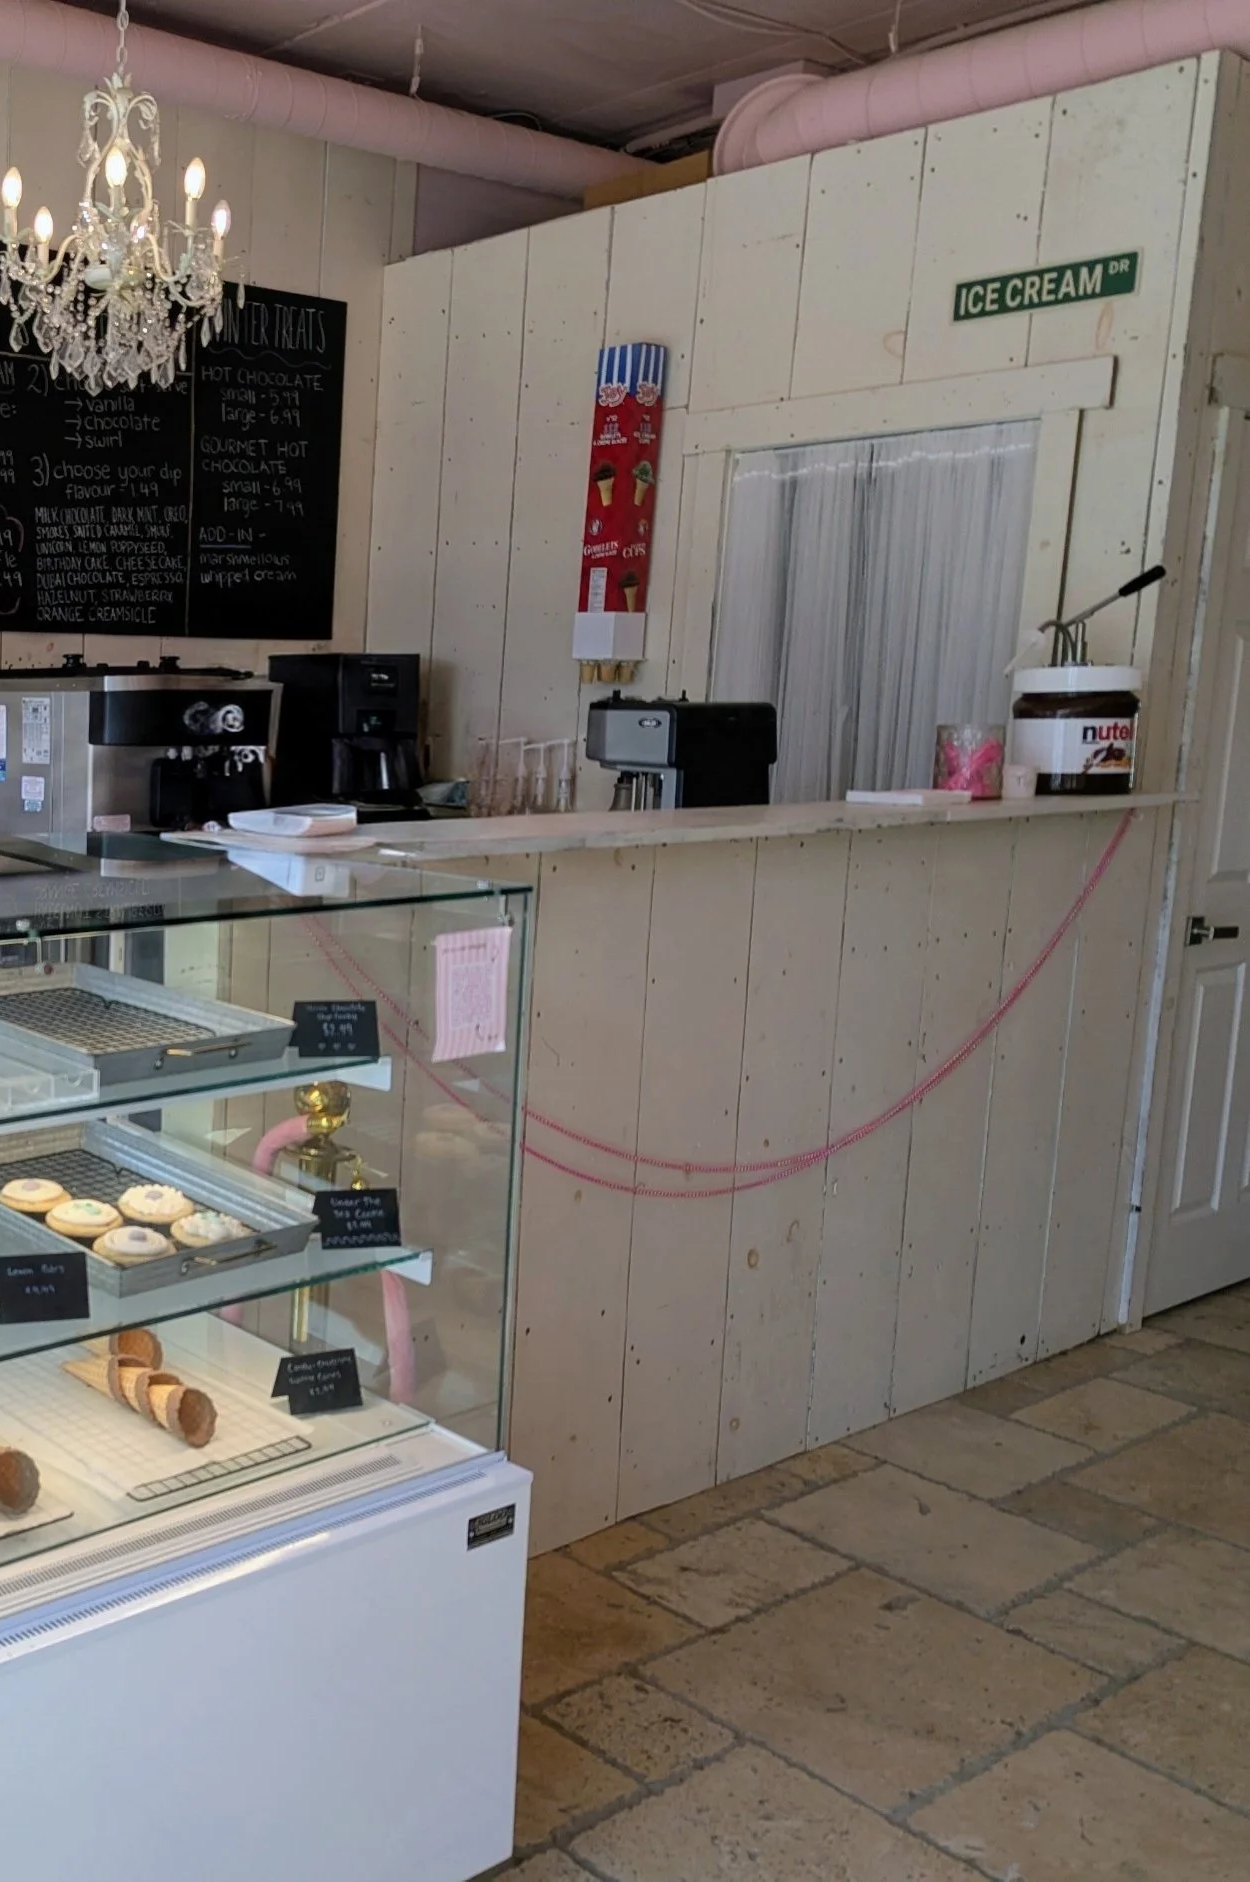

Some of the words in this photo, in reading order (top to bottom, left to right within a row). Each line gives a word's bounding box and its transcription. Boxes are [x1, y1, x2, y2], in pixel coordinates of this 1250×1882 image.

[959, 281, 1001, 317] ICE
[1005, 263, 1104, 308] CREAM
[1108, 258, 1130, 275] DR
[274, 303, 326, 353] TREATS
[201, 365, 232, 382] HOT
[237, 367, 324, 391] CHOCOLATE
[85, 396, 136, 412] vanilla
[220, 387, 256, 405] small
[84, 414, 161, 431] chocolate
[221, 402, 256, 431] large
[85, 430, 123, 449] swirl
[200, 435, 269, 457] GOURMET
[277, 440, 309, 458] HOT
[53, 460, 111, 480] choose
[118, 463, 156, 487] your
[159, 461, 183, 487] dip
[201, 459, 288, 475] CHOCOLATE
[65, 483, 117, 500] flavour
[222, 479, 261, 495] small
[34, 506, 59, 523] MILK
[224, 496, 260, 519] large
[273, 499, 305, 517] 799
[78, 540, 107, 554] LEMON
[36, 556, 82, 571] BIRTHDAY
[36, 573, 65, 590] DUBAI
[200, 567, 250, 588] whipped
[253, 569, 298, 582] cream
[37, 606, 85, 622] ORANGE
[88, 606, 157, 624] CREAMSICLE
